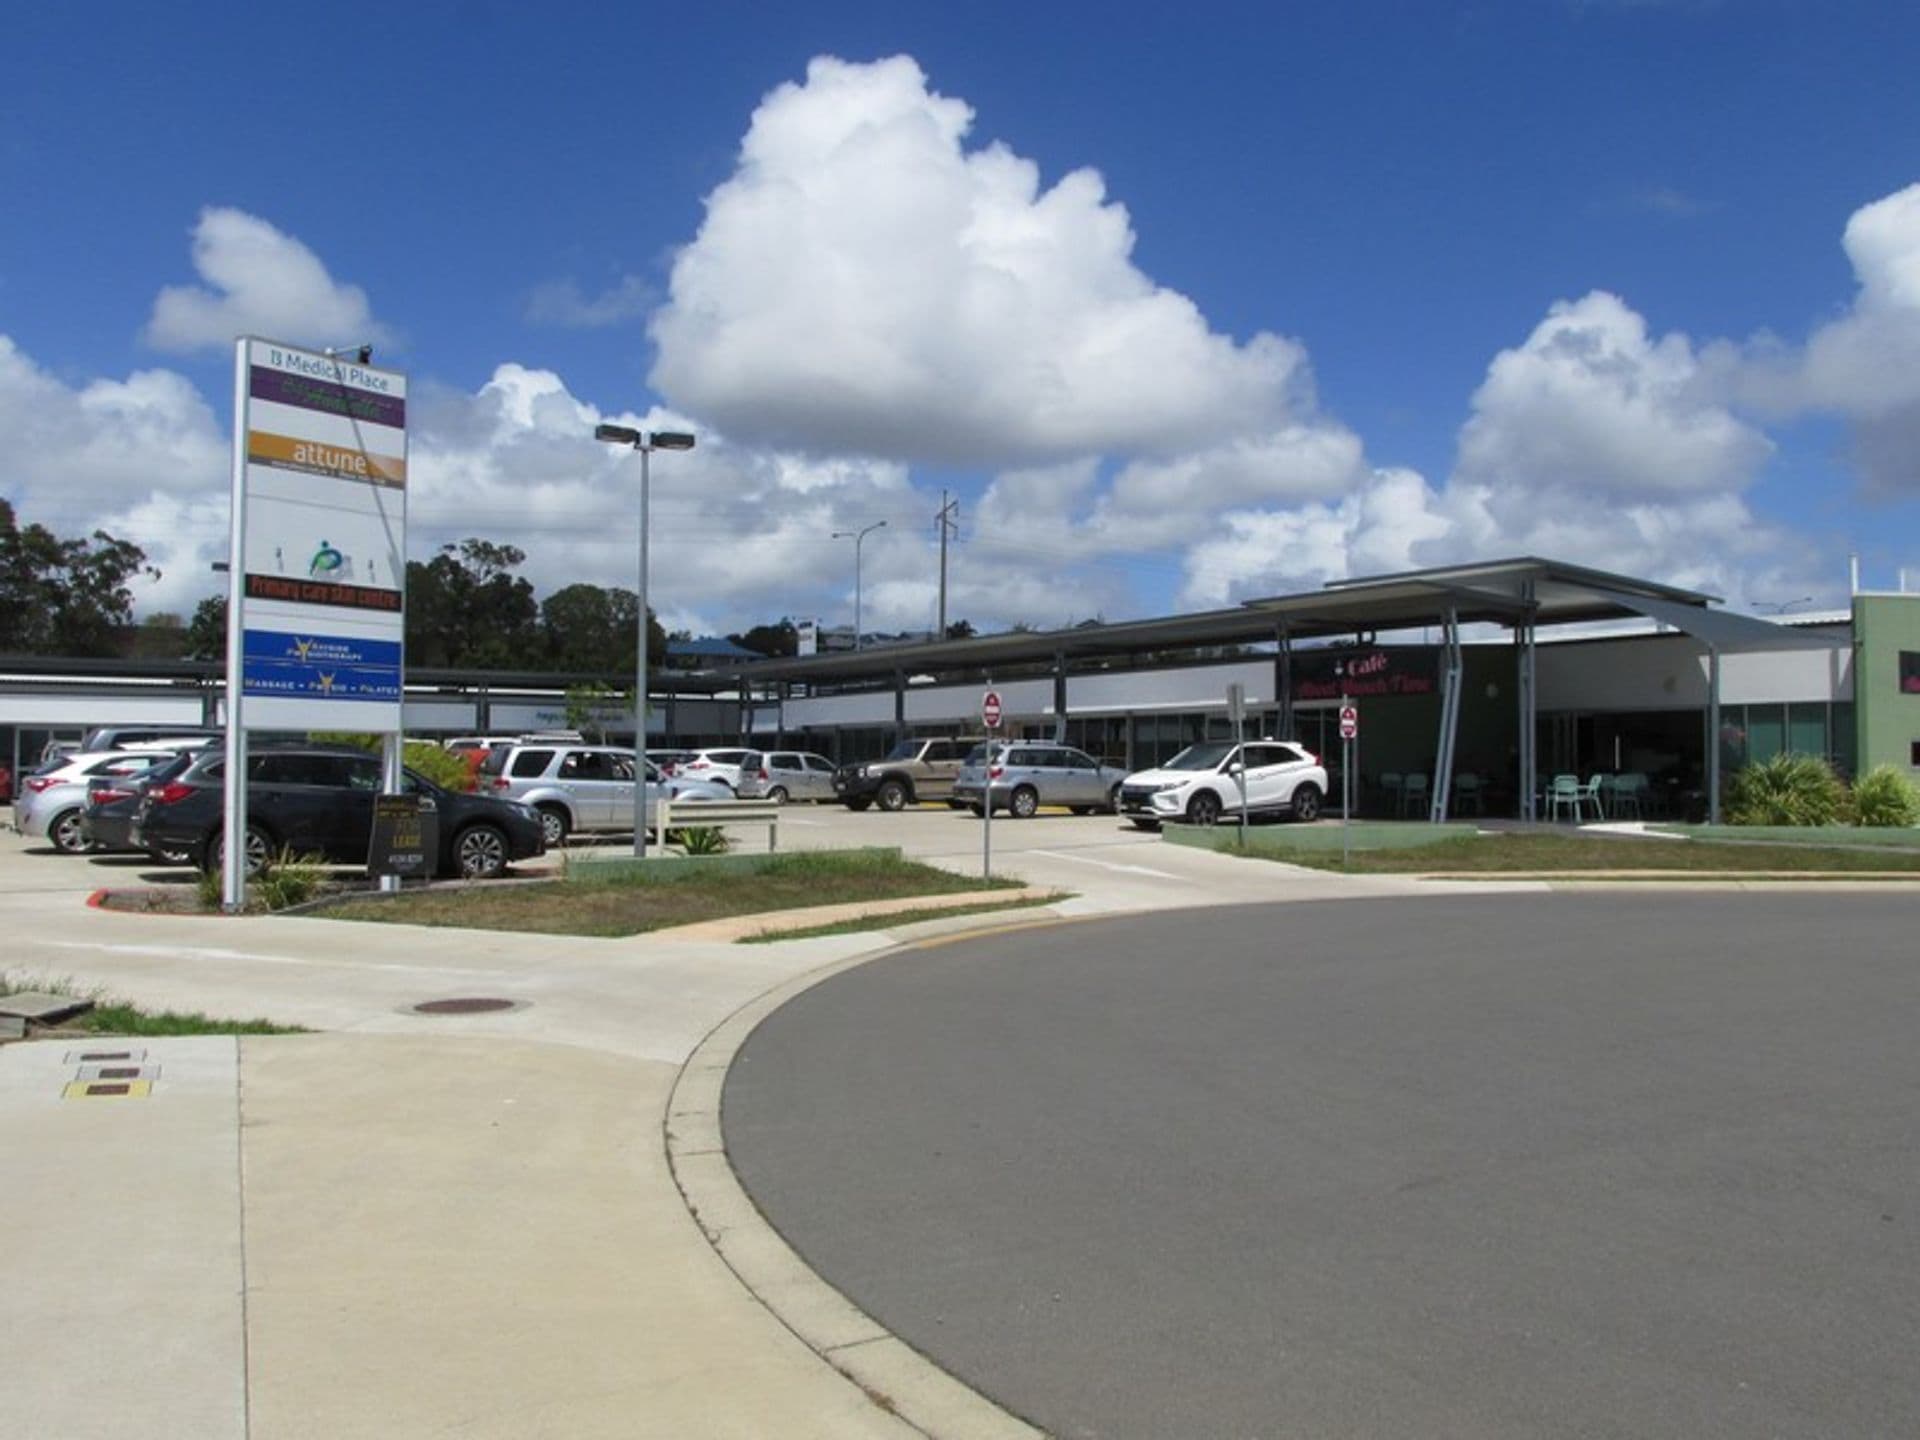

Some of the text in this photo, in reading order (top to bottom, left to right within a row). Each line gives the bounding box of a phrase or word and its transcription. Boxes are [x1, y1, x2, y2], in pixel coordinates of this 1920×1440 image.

[271, 349, 388, 391] 13 Medical Place
[293, 442, 368, 474] attune
[1348, 653, 1388, 677] Café
